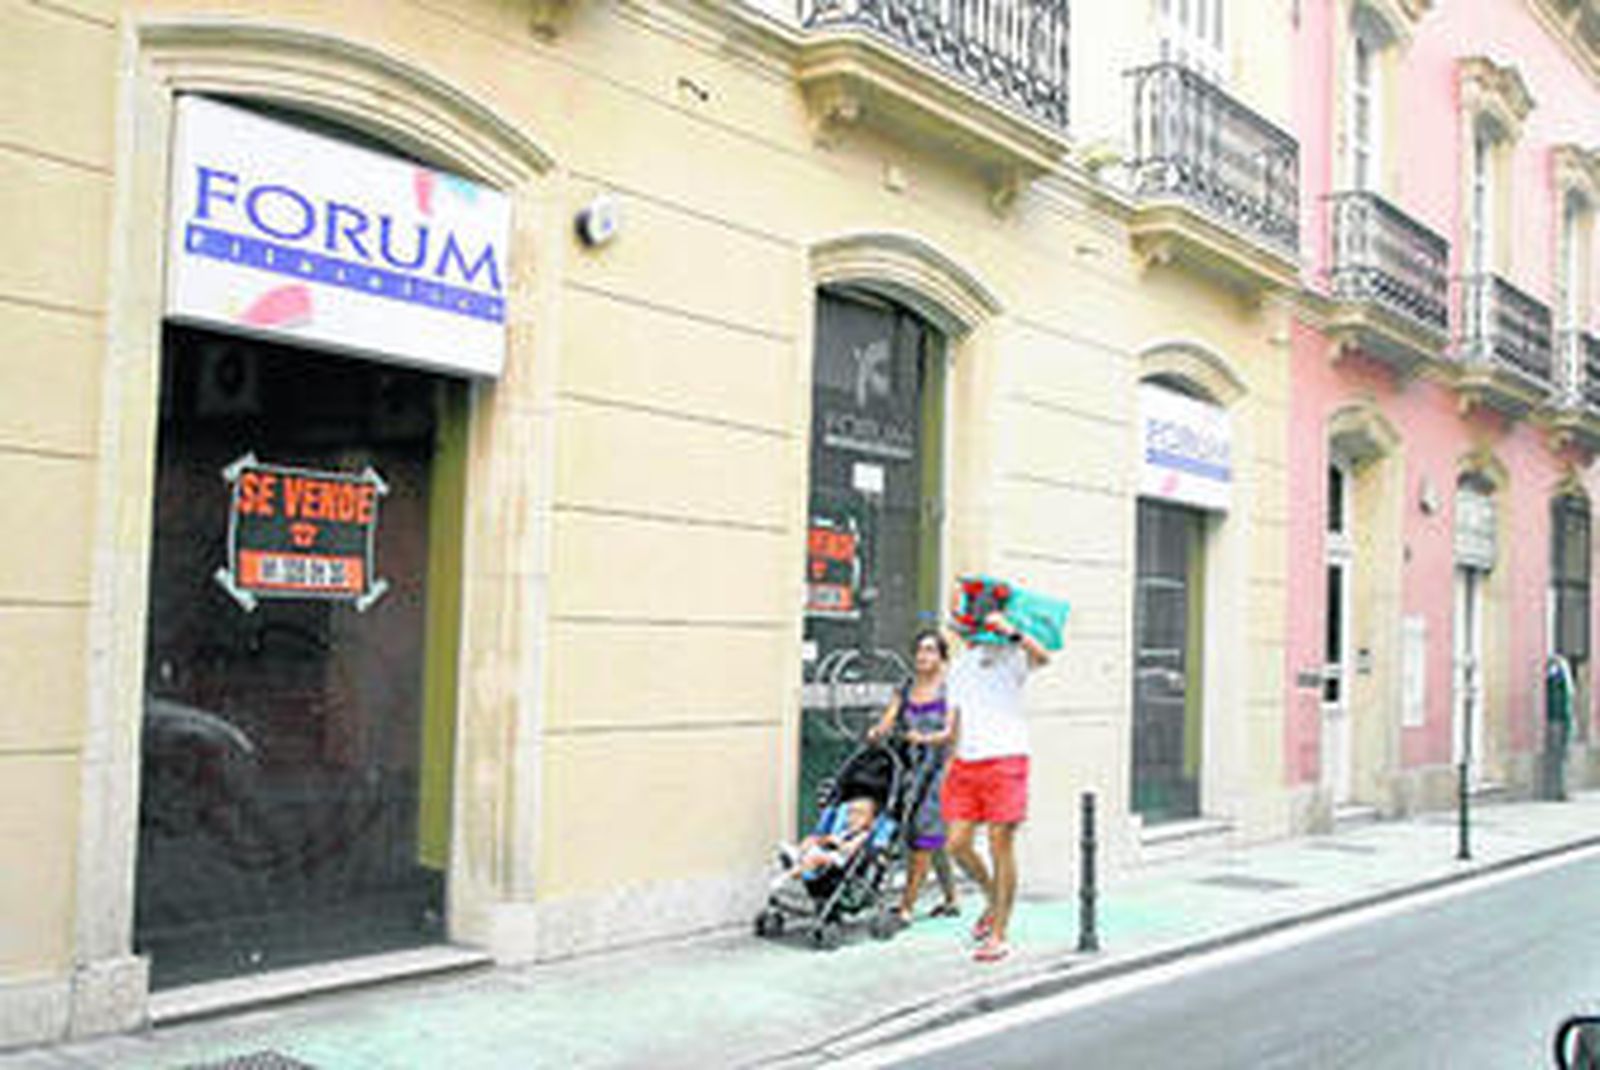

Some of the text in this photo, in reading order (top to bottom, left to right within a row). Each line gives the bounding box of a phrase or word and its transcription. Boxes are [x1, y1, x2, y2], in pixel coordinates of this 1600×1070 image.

[195, 164, 503, 292] FORUM
[238, 472, 377, 524] SE VENDE
